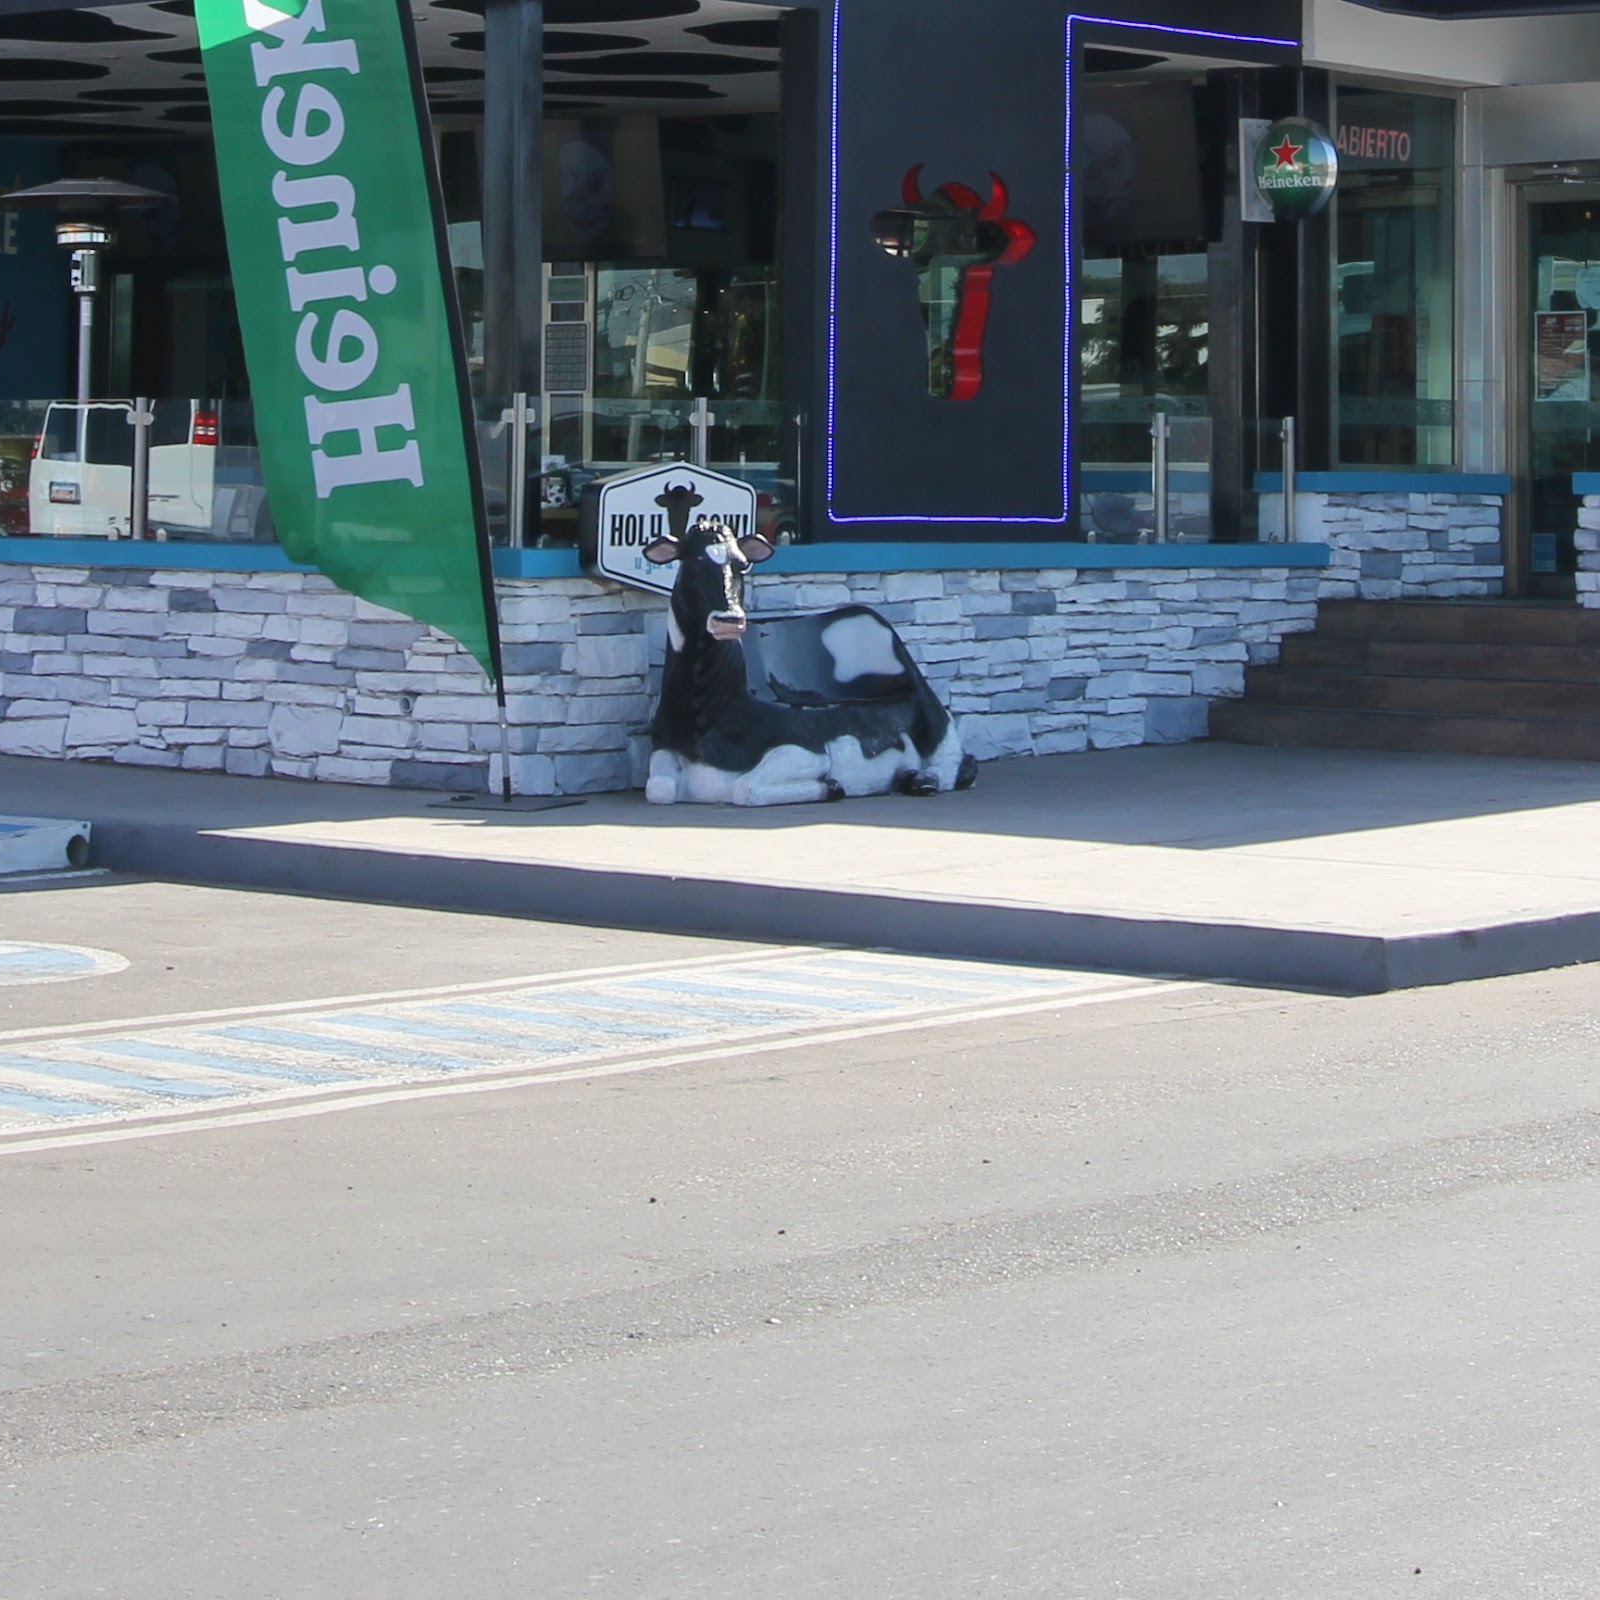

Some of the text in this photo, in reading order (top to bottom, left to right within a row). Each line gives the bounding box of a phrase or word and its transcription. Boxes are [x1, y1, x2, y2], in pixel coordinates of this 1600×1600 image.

[1336, 125, 1411, 162] ABIERTO
[1258, 173, 1321, 189] Heineken
[610, 513, 663, 547] HOLY
